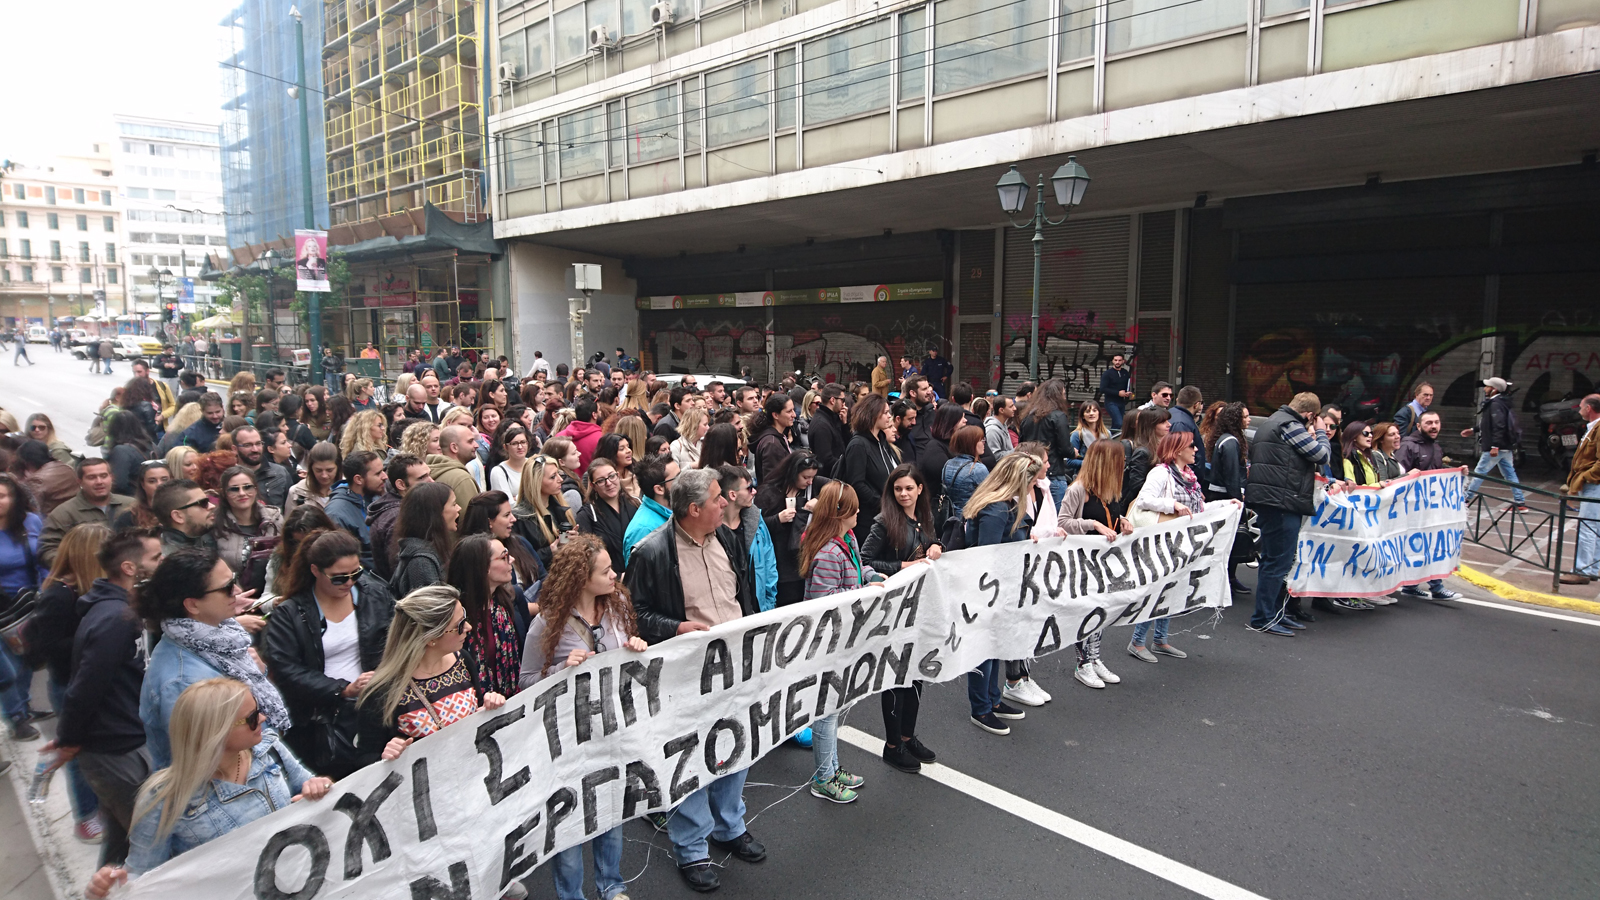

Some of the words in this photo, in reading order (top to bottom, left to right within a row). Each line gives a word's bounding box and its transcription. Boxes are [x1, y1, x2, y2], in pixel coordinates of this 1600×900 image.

[971, 268, 983, 279] 29
[1018, 519, 1226, 609] ΚΟΙΝΩΝΙΚΕΣ
[253, 756, 438, 900] ΟΧΙ
[474, 656, 664, 806] ΣΤΗΝ
[700, 574, 926, 695] ΑΠΟΛΥΣΗ
[499, 642, 914, 892] ΕΡΓΑΖΟΜΕΝΩΝ
